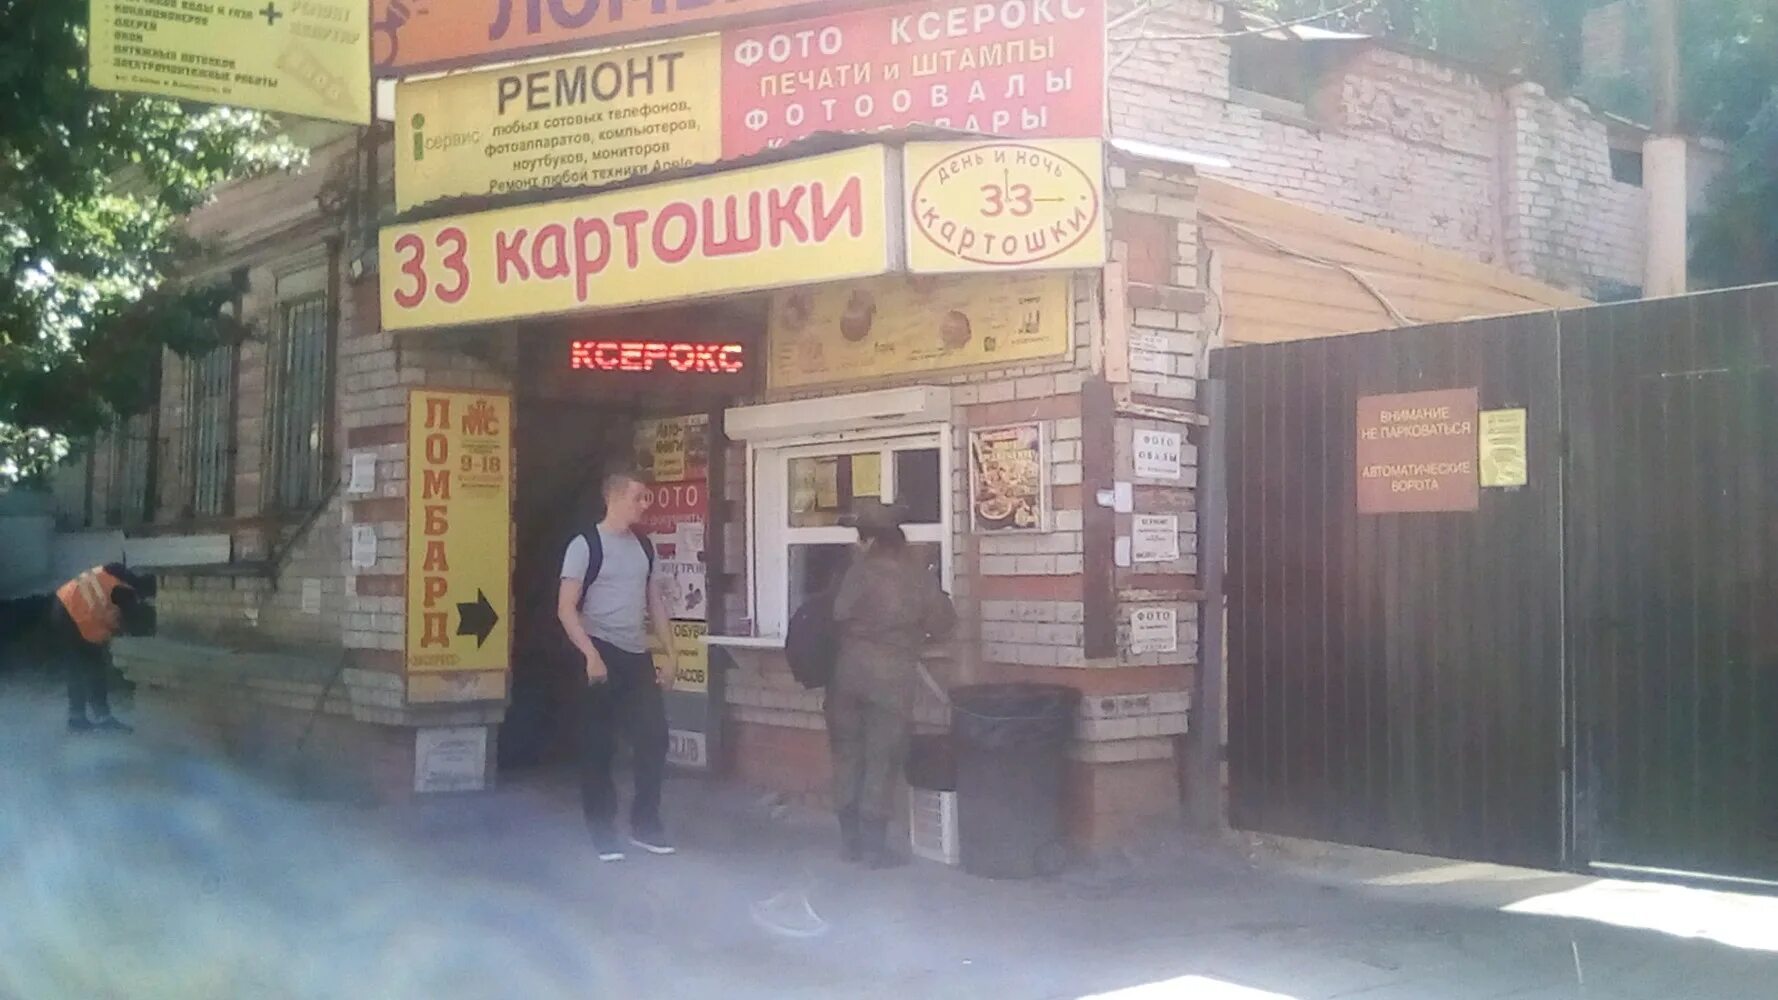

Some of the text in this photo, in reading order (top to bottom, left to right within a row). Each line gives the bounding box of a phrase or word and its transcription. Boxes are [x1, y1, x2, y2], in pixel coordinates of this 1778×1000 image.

[733, 0, 1086, 66] ФОТО КСЕРОКС
[761, 62, 872, 97] ПЕЧАТИ
[911, 35, 1055, 77] ШТАМПЫ
[498, 52, 684, 115] РЕМОНТ
[484, 119, 701, 158] фотоаппаратов, компьютеров,
[492, 120, 540, 137] любых
[543, 112, 604, 129] сотовых
[512, 142, 671, 171] ноутбуков, мониторов
[488, 177, 540, 194] Ремонт
[542, 169, 589, 186] любой
[591, 161, 649, 182] техники
[980, 183, 1034, 217] 33
[392, 176, 864, 309] 33 картошки
[569, 339, 744, 373] КСЕРОКС
[1361, 429, 1377, 440] НЕ
[1381, 422, 1471, 438] ПАРКОВАТЬСЯ
[1380, 407, 1449, 423] ВНИМАНИЕ
[1362, 462, 1471, 478] АВТОМАТИЧЕСКИЕ
[1391, 480, 1439, 492] ВОРОТА
[421, 399, 450, 648] ЛОМБАРД
